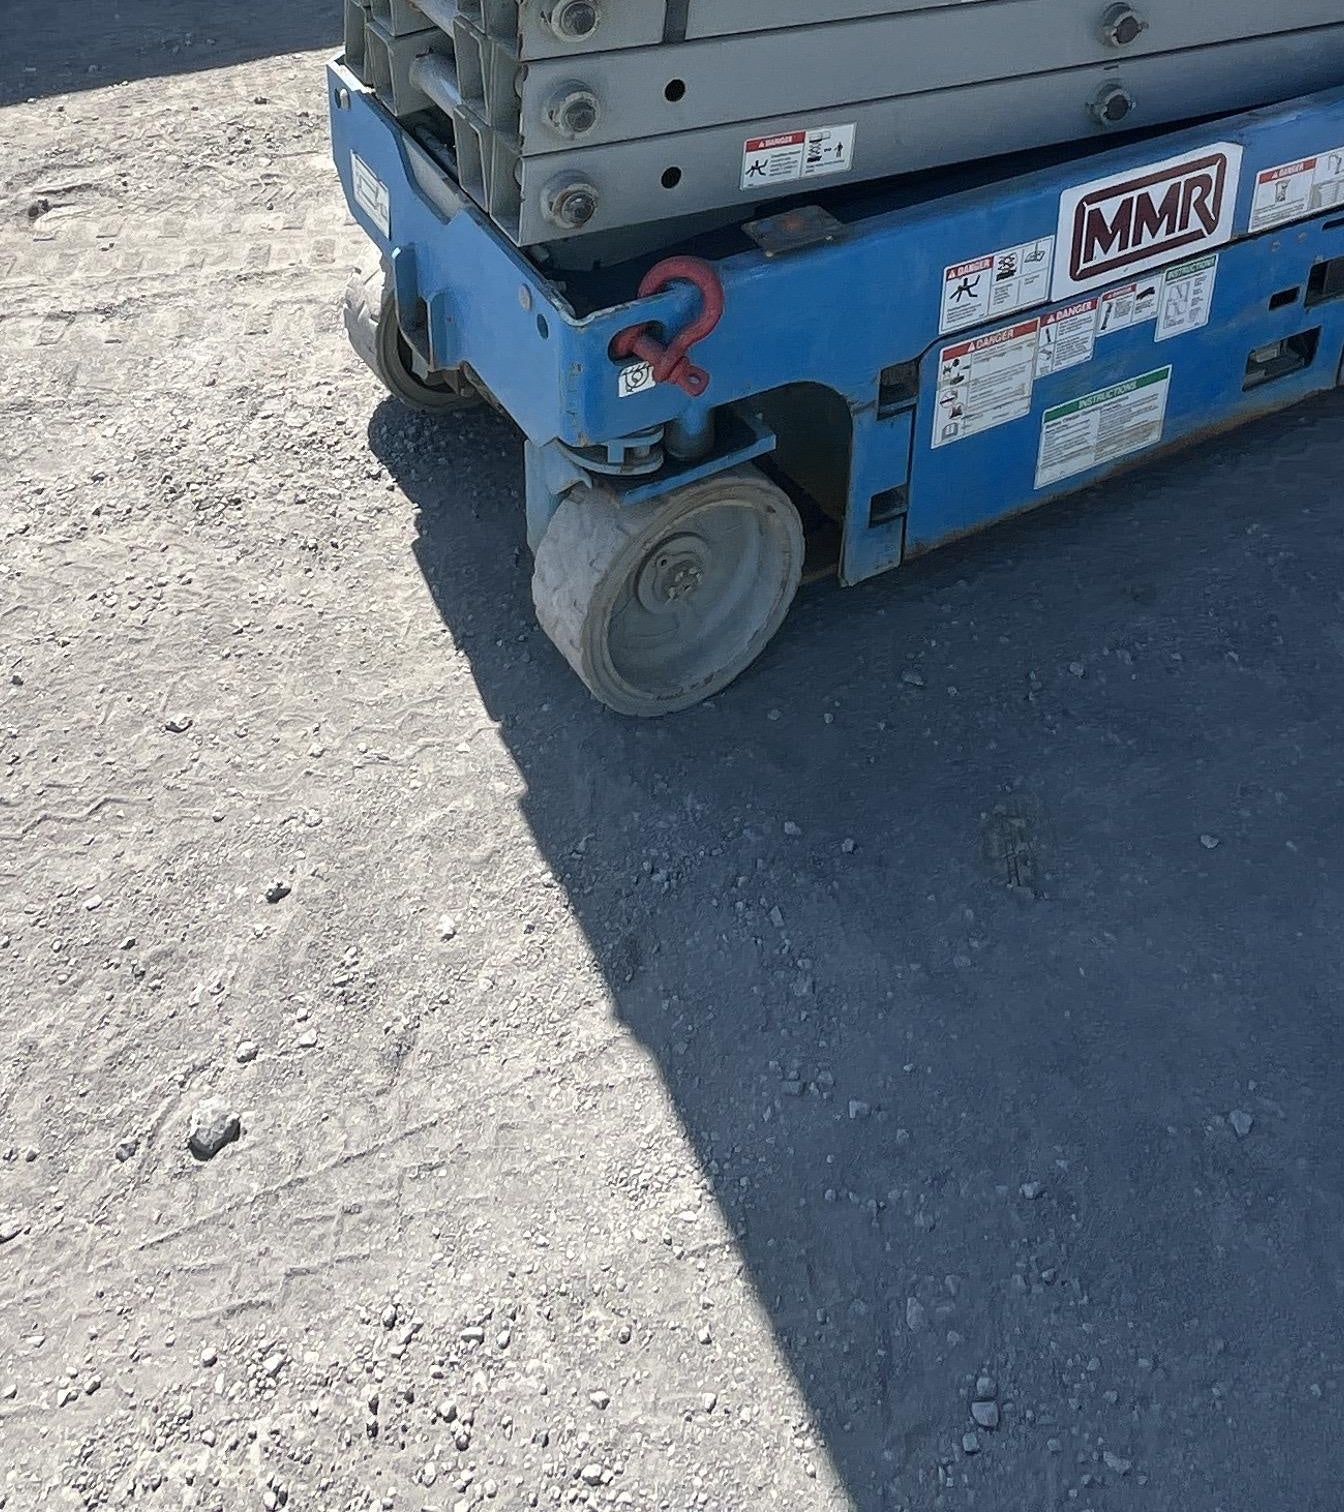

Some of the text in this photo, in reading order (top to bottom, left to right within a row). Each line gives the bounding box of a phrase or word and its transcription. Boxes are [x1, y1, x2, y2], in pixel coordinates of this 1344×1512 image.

[1083, 173, 1218, 265] MMR
[957, 258, 991, 275] DANGER
[1056, 300, 1093, 320] DANGER
[976, 328, 1015, 349] DANGER
[1078, 381, 1138, 410] INSTRUCTIONS
